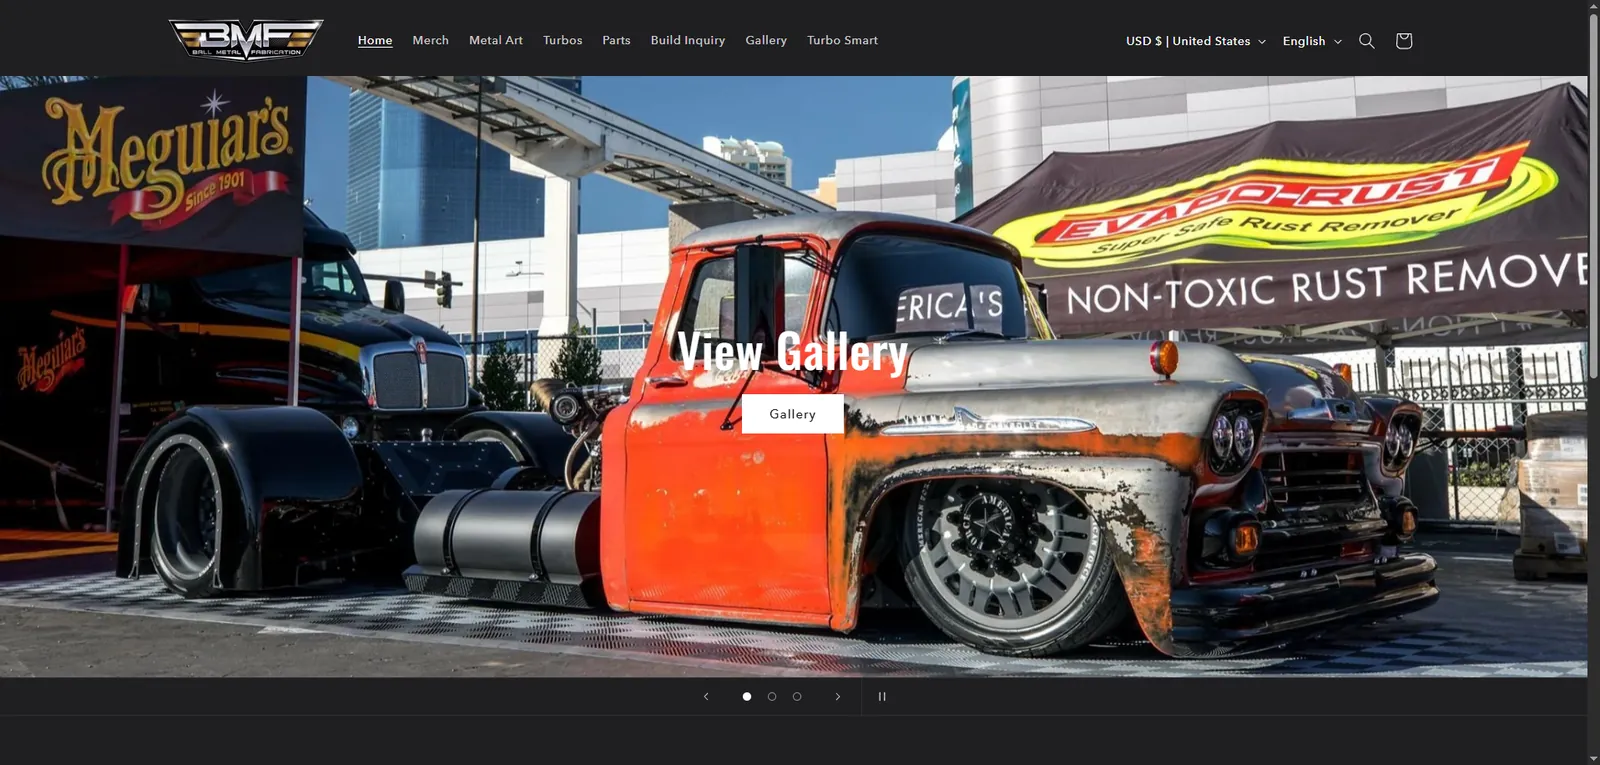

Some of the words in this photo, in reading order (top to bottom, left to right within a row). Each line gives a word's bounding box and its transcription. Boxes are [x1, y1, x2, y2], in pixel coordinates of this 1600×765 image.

[42, 96, 290, 220] Meguiar's
[185, 183, 217, 212] Since
[218, 170, 245, 192] 1901
[1054, 157, 1501, 242] EVAPO-RUST
[1091, 230, 1171, 254] Super
[1173, 215, 1233, 236] Safe
[1239, 216, 1314, 233] Rust
[1317, 207, 1462, 233] Remover
[1068, 275, 1275, 315] NON-TOXIC
[1292, 265, 1387, 303] RUST
